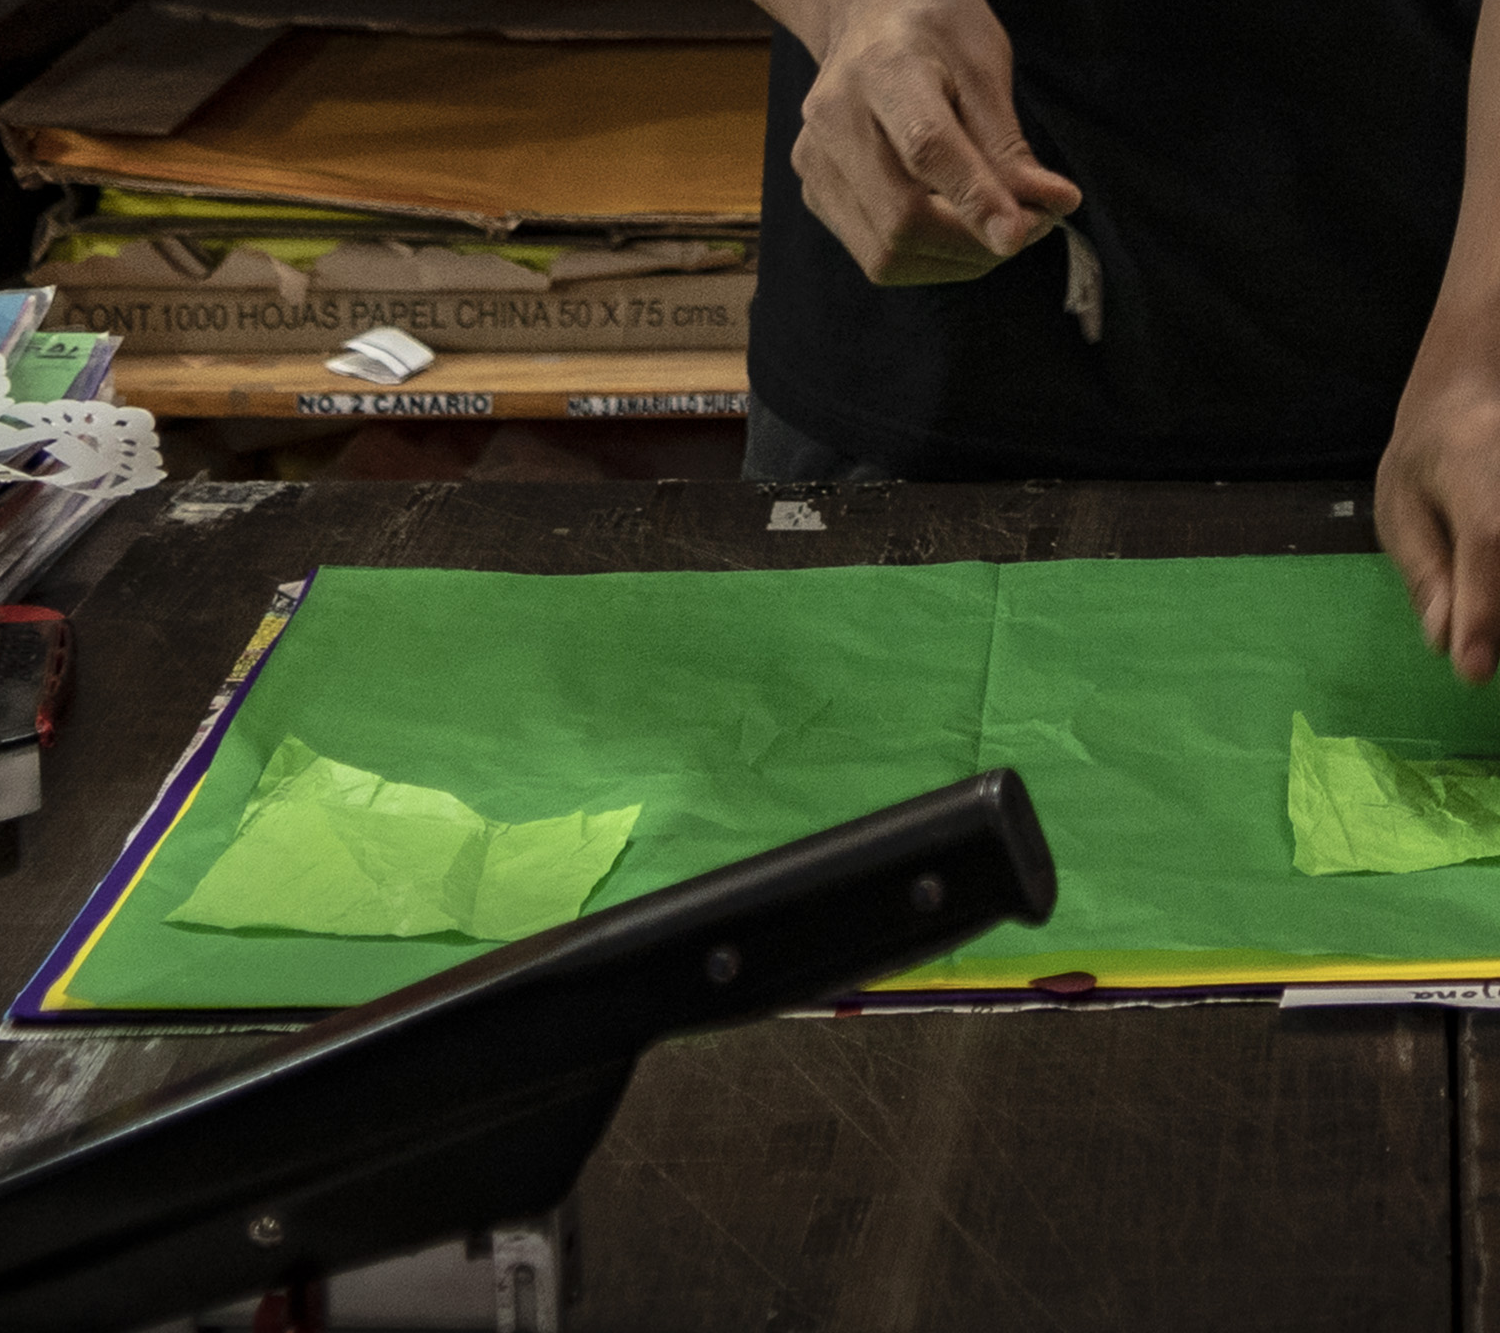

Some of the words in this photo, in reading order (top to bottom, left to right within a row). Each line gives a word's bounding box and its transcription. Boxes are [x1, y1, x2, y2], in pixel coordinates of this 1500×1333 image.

[237, 300, 340, 331] HOJAS
[351, 298, 446, 331] PAPEL
[454, 298, 549, 330] CHINA
[556, 298, 594, 329] 50
[595, 298, 618, 329] X
[626, 297, 664, 329] 75
[669, 303, 738, 327] cms.
[297, 394, 341, 416] NO.
[350, 394, 364, 415] 2
[373, 394, 491, 415] CANARIO
[612, 397, 689, 416] AMARILLO
[693, 396, 747, 415] HUEV
